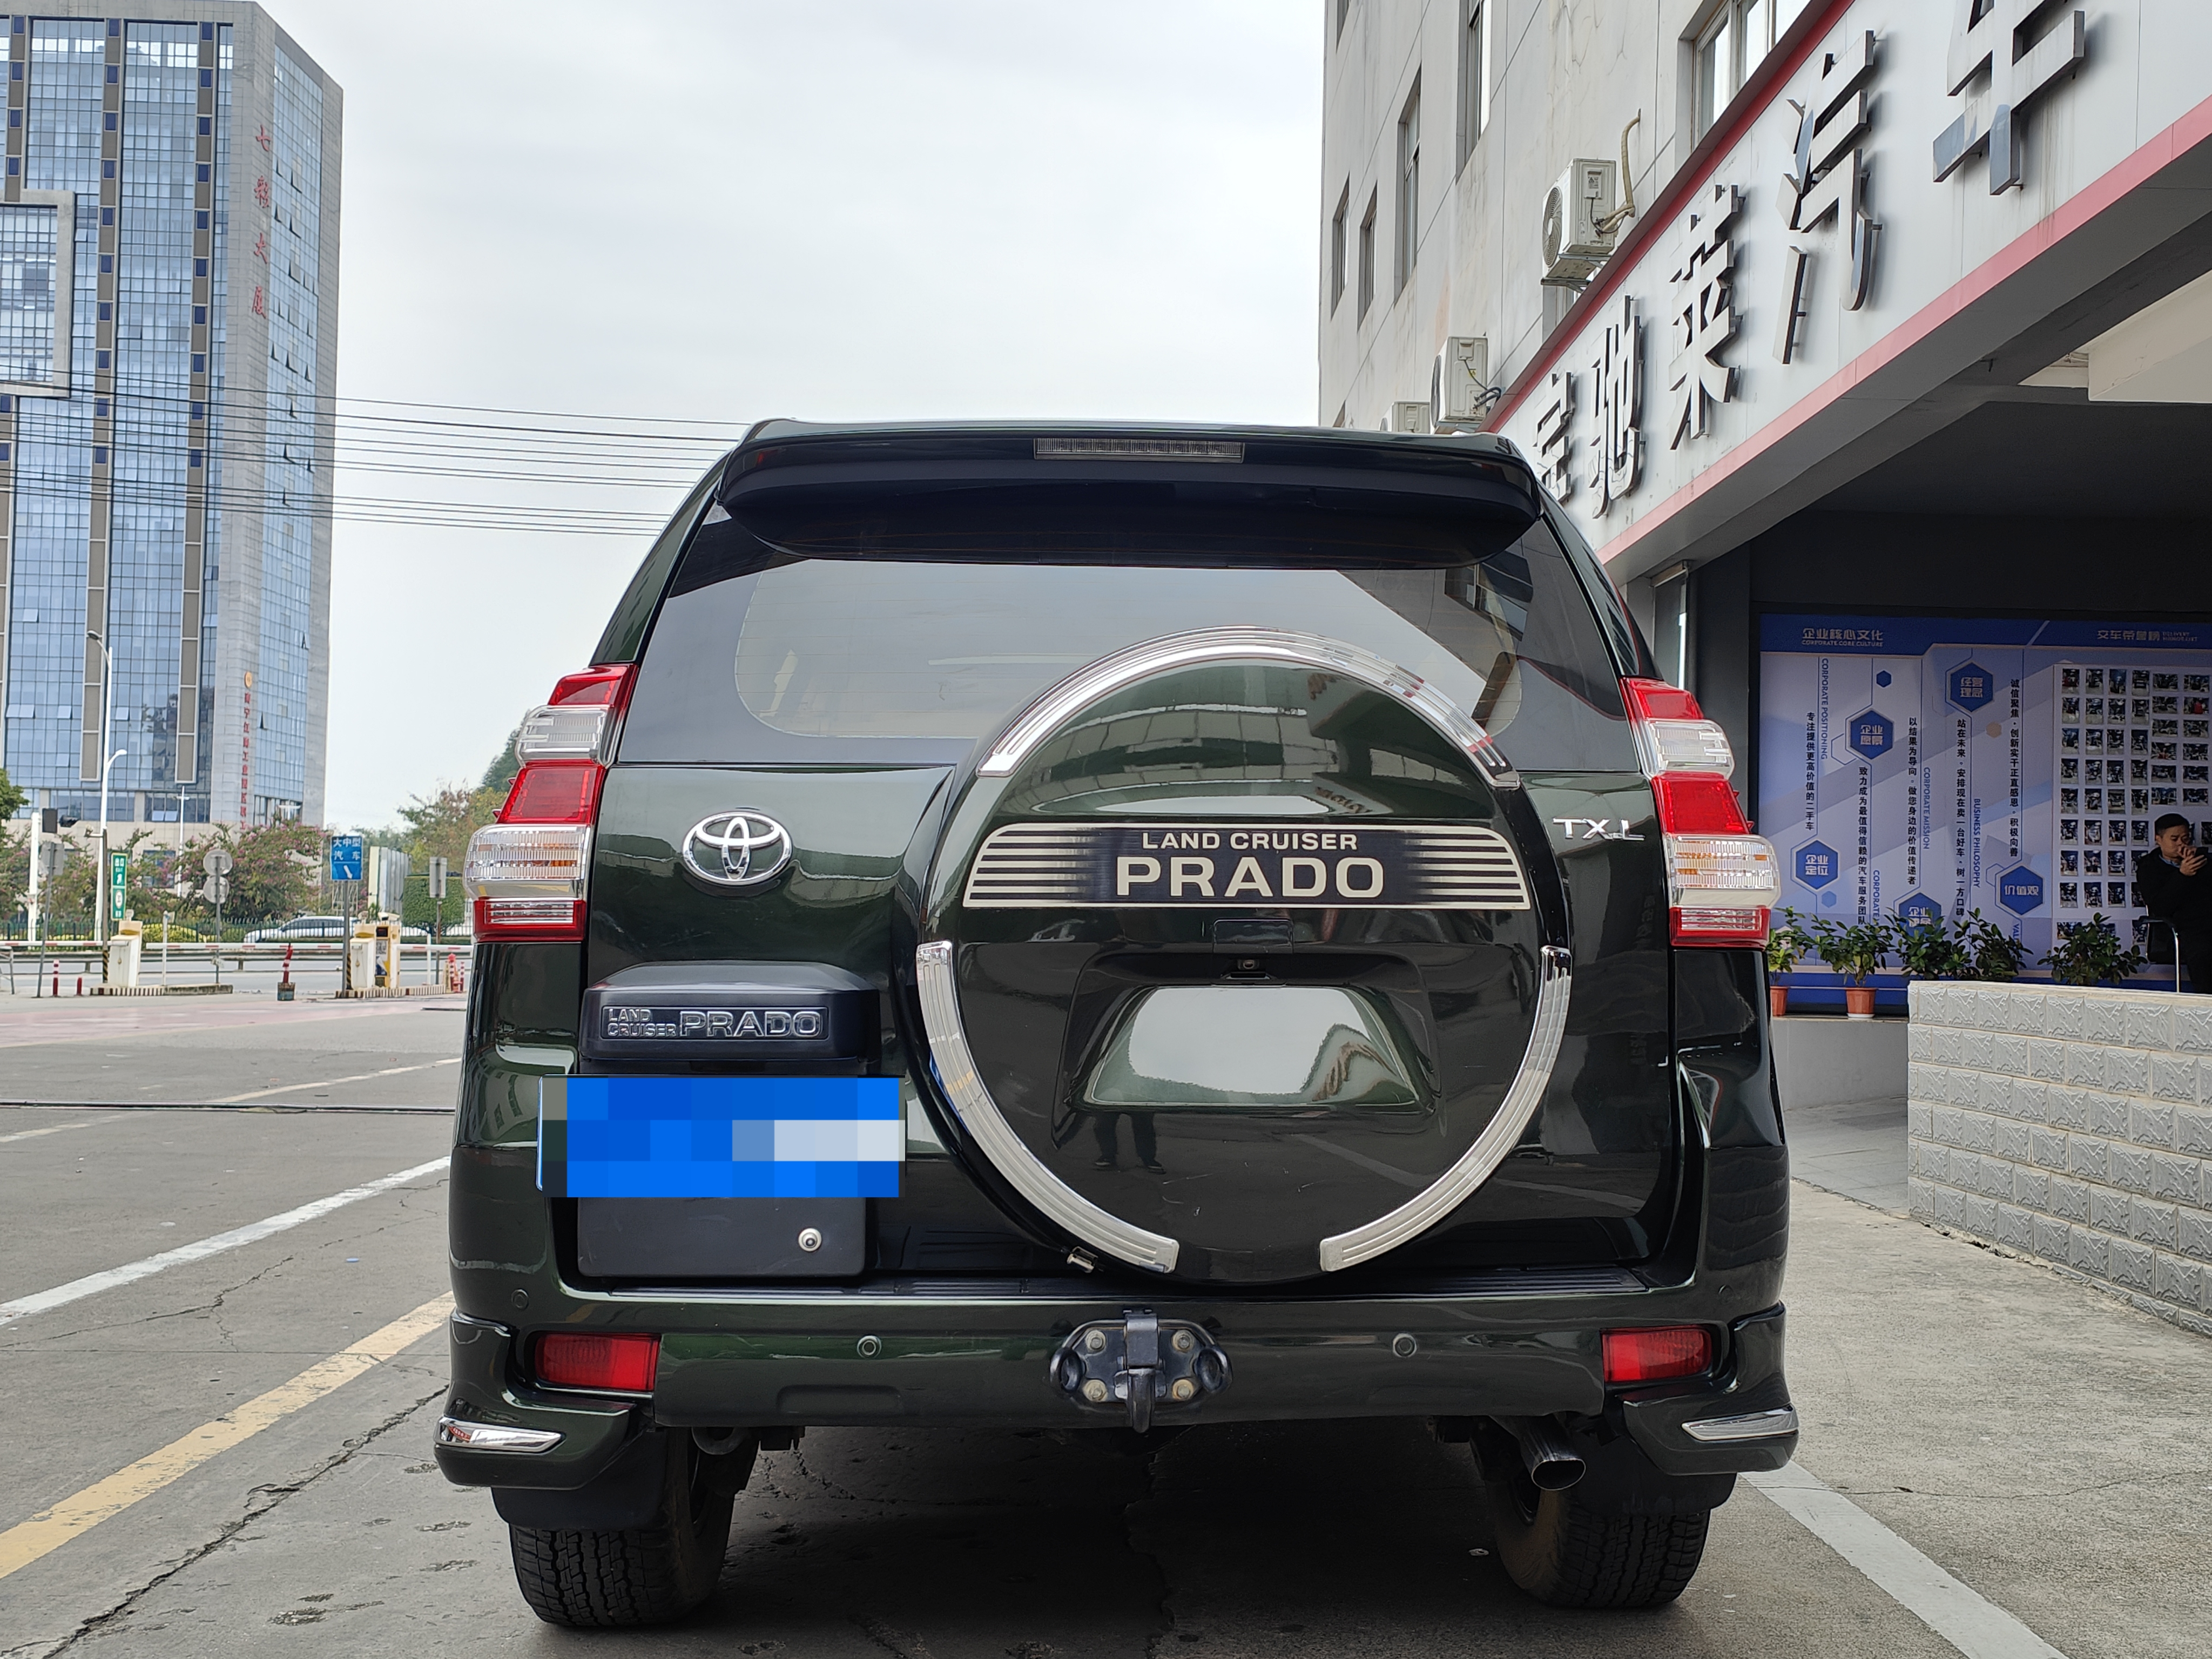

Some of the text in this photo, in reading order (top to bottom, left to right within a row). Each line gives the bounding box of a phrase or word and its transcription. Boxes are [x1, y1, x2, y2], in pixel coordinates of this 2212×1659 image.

[252, 125, 271, 319] 七彩大厦
[1802, 628, 1884, 641] 企业核心文化
[1860, 724, 1883, 734] 企业
[1805, 712, 1815, 831] 专注提供更高价值的二手车
[333, 838, 361, 847] 大中型
[1142, 832, 1358, 850] LAND CRUISER
[1858, 766, 1868, 925] 致力成为最值得信赖的汽车服务团队
[334, 851, 361, 861] 汽车
[1805, 854, 1829, 865] 企业
[1117, 856, 1384, 898] PRADO
[1805, 865, 1829, 875] 定位
[2005, 885, 2039, 896] 价值观
[608, 1008, 651, 1022] LAND
[608, 1022, 677, 1037] CRUISER
[679, 1010, 822, 1037] PRADO
